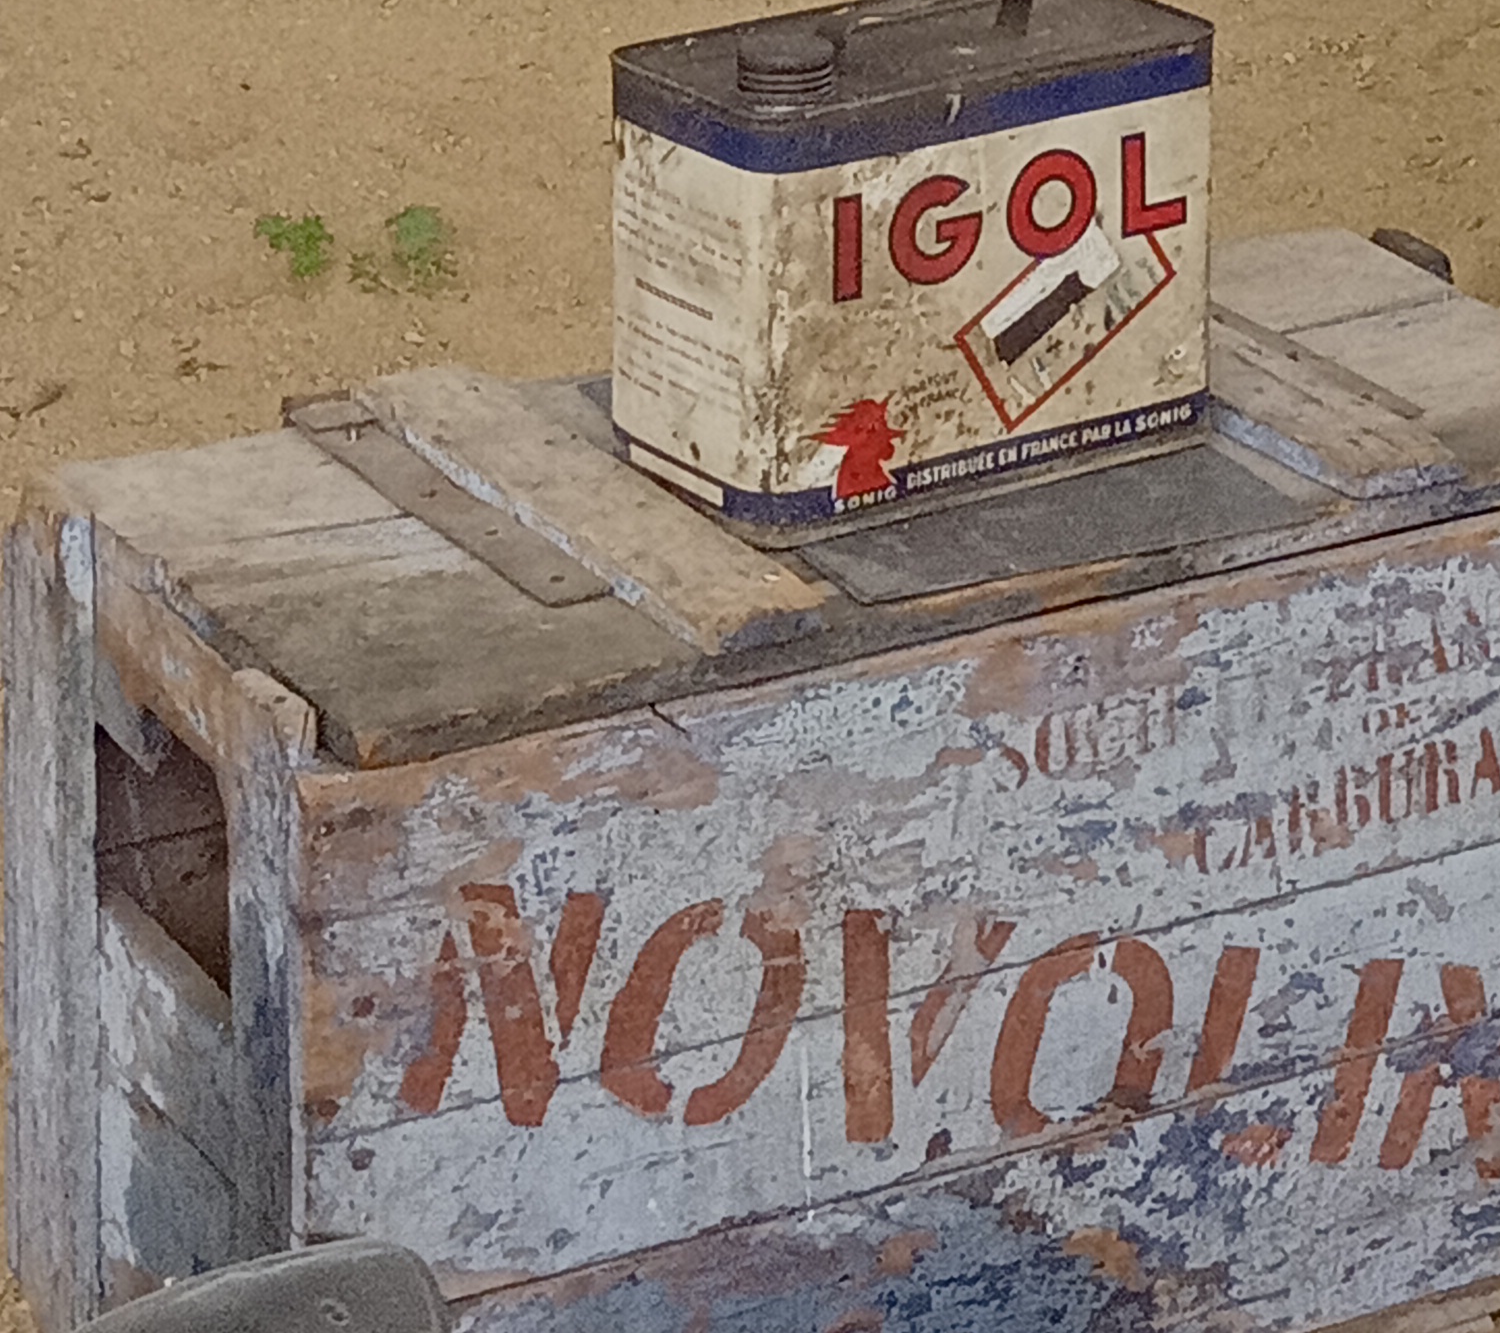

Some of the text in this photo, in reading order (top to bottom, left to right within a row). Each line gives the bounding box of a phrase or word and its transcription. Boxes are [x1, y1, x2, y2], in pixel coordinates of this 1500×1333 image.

[833, 131, 1188, 304] IGOL
[998, 445, 1019, 467] EN
[1020, 430, 1080, 462] FRANCE
[1081, 423, 1112, 446] PAR
[1114, 419, 1133, 438] LA
[1134, 402, 1193, 434] SONIG
[834, 484, 898, 515] SONIG
